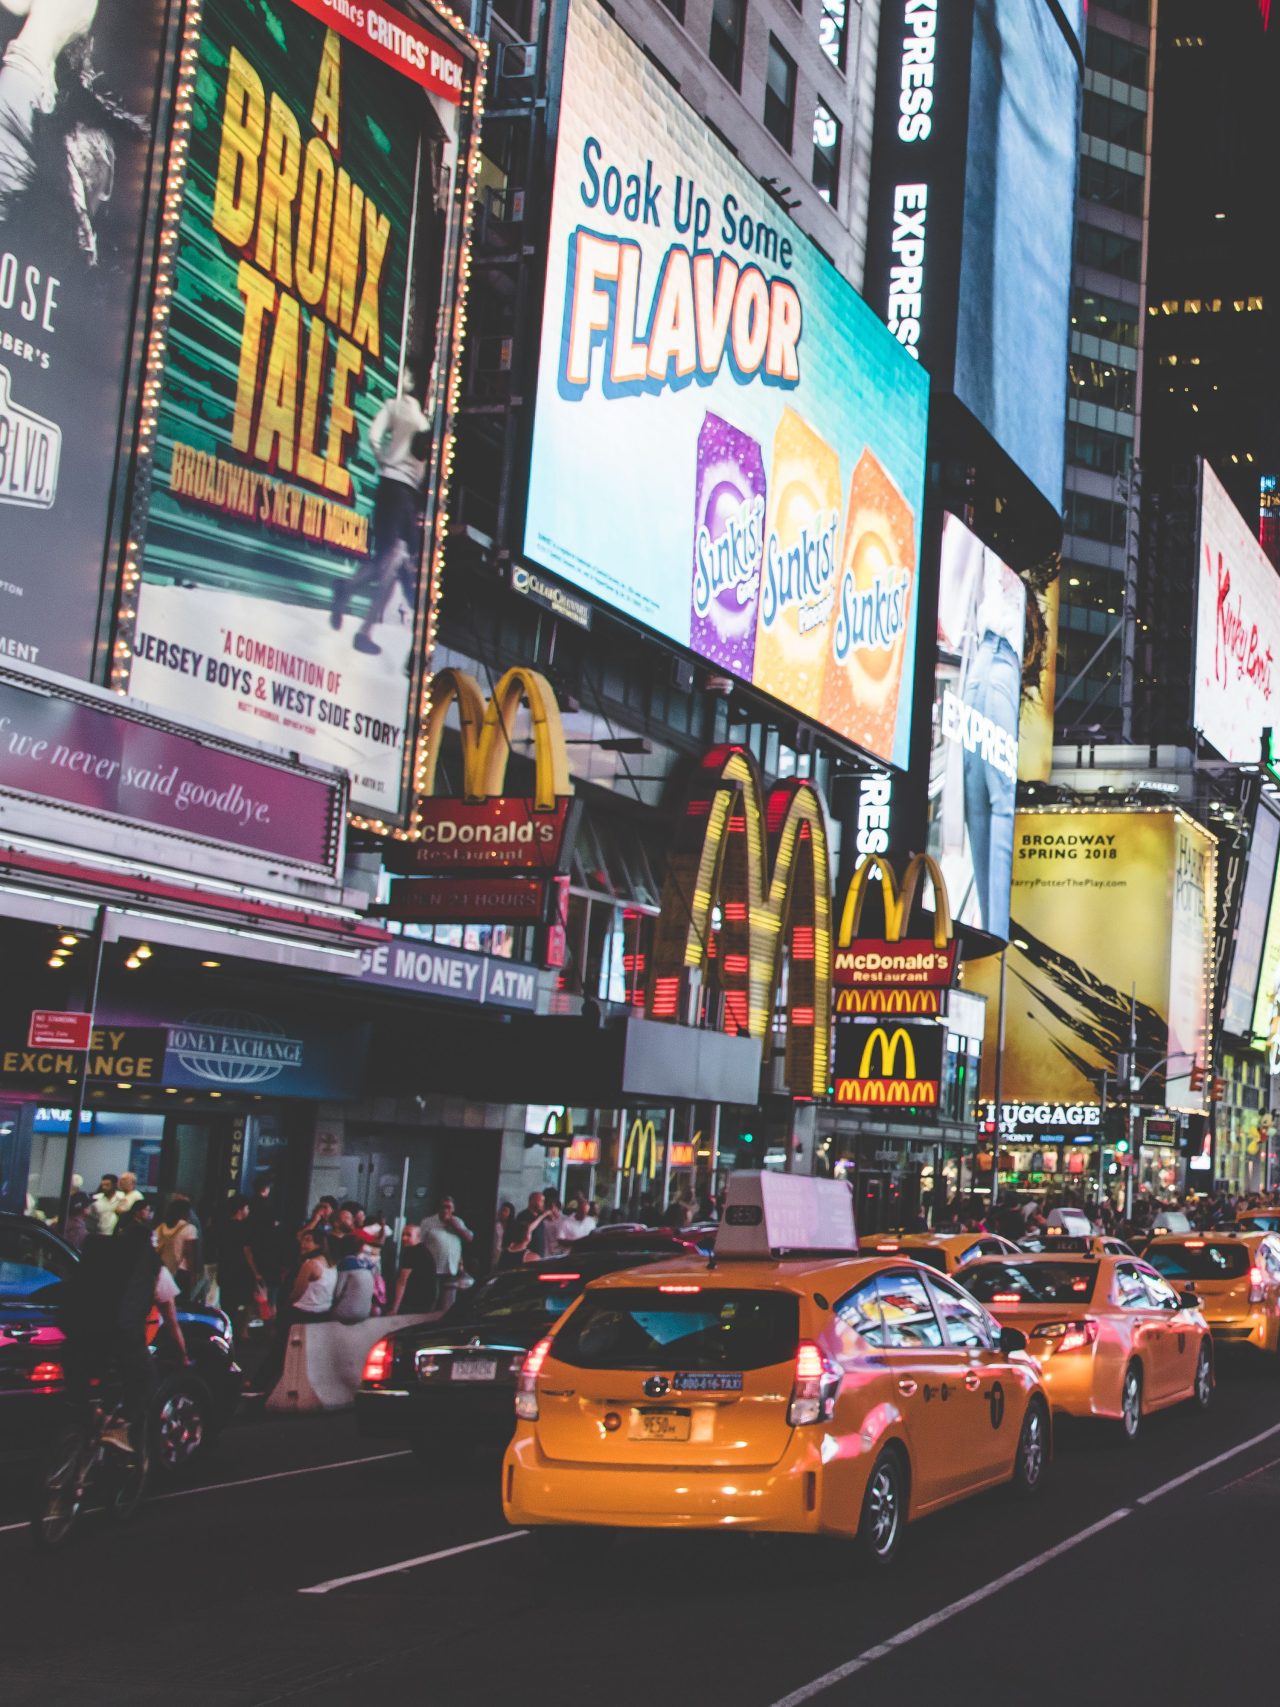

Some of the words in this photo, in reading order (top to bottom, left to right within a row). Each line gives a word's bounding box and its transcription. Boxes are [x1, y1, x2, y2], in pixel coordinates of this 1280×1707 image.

[311, 25, 343, 150] A
[367, 10, 429, 69] CRITICS'
[431, 50, 464, 90] PICK
[212, 46, 391, 357] BRONX
[580, 136, 661, 226] Soak
[673, 176, 711, 251] Up
[721, 195, 793, 270] Some
[558, 226, 801, 400] FLAVOR
[232, 261, 361, 497] TALE
[170, 441, 270, 520] BROADWAY'S
[272, 481, 303, 530] NEW
[323, 501, 369, 554] MUSICAL
[696, 504, 762, 612] Sunkist
[763, 512, 837, 627] Sunkist
[835, 570, 908, 660] Sunkist
[134, 632, 203, 678] JERSEY
[206, 658, 251, 696] BOYS
[255, 676, 267, 700] &
[272, 681, 315, 717] WEST
[318, 702, 350, 731] SIDE
[236, 635, 324, 690] COMBINATION
[327, 673, 342, 695] OF
[8, 732, 47, 761] we
[51, 744, 120, 781] never
[120, 763, 175, 797] said
[175, 778, 271, 827] goodbye.
[420, 820, 554, 843] cDonald's
[1018, 848, 1078, 860] SPRING
[1084, 848, 1118, 860] 2018
[1022, 834, 1116, 846] BROADWAY
[394, 949, 480, 992] MONEY
[490, 969, 536, 1001] ATM
[835, 953, 948, 970] McDonald's
[853, 971, 928, 982] Restaurant
[221, 1033, 303, 1062] EXCHANGE
